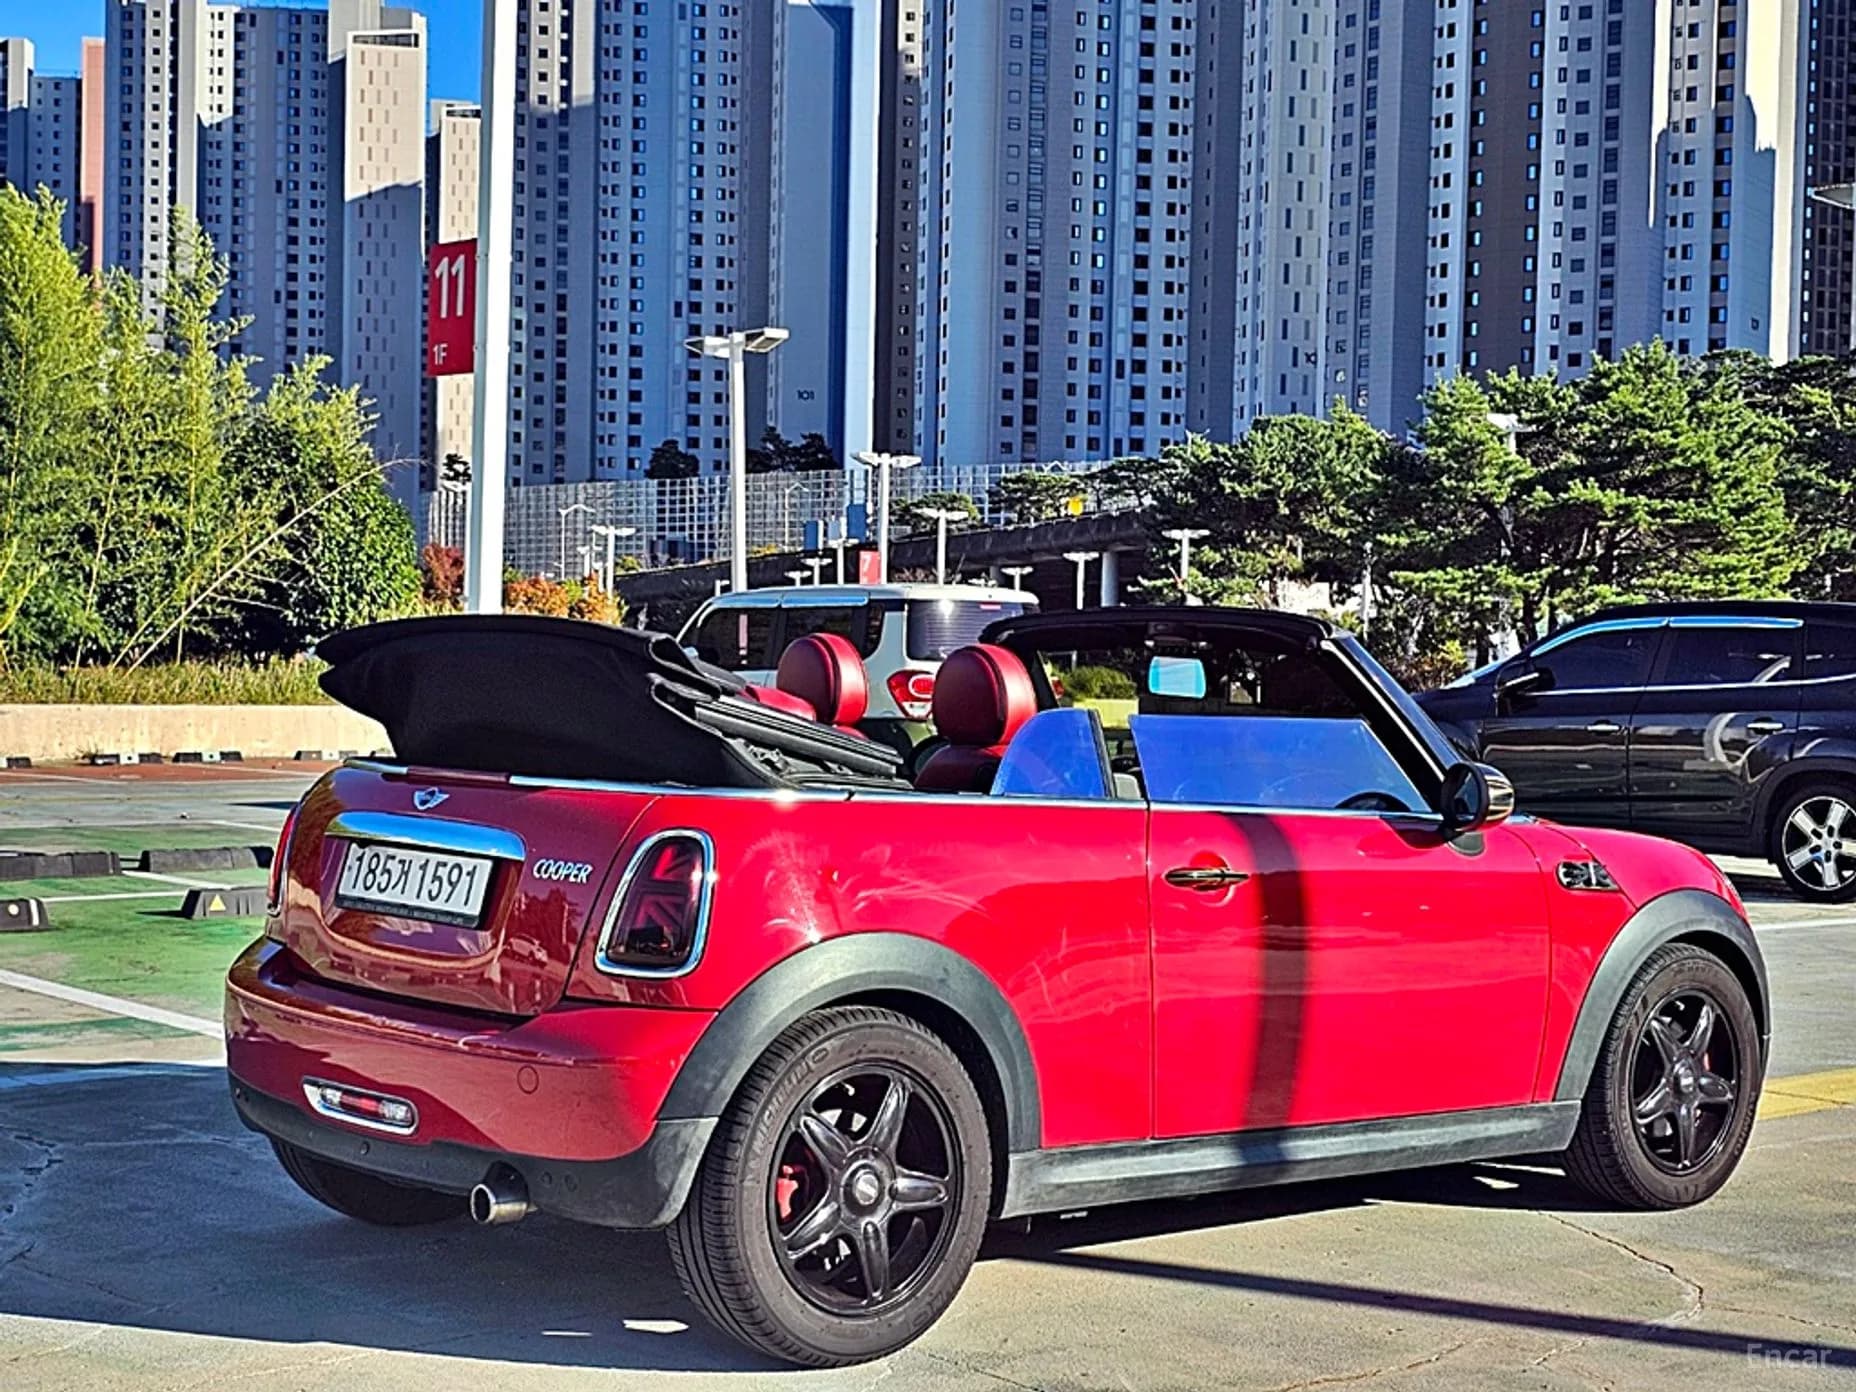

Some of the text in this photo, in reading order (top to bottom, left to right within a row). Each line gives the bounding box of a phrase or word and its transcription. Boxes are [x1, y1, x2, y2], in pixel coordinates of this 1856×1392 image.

[435, 254, 465, 318] 11
[433, 343, 448, 365] 1F
[351, 850, 477, 907] 185거 1591
[533, 859, 593, 884] COOPER
